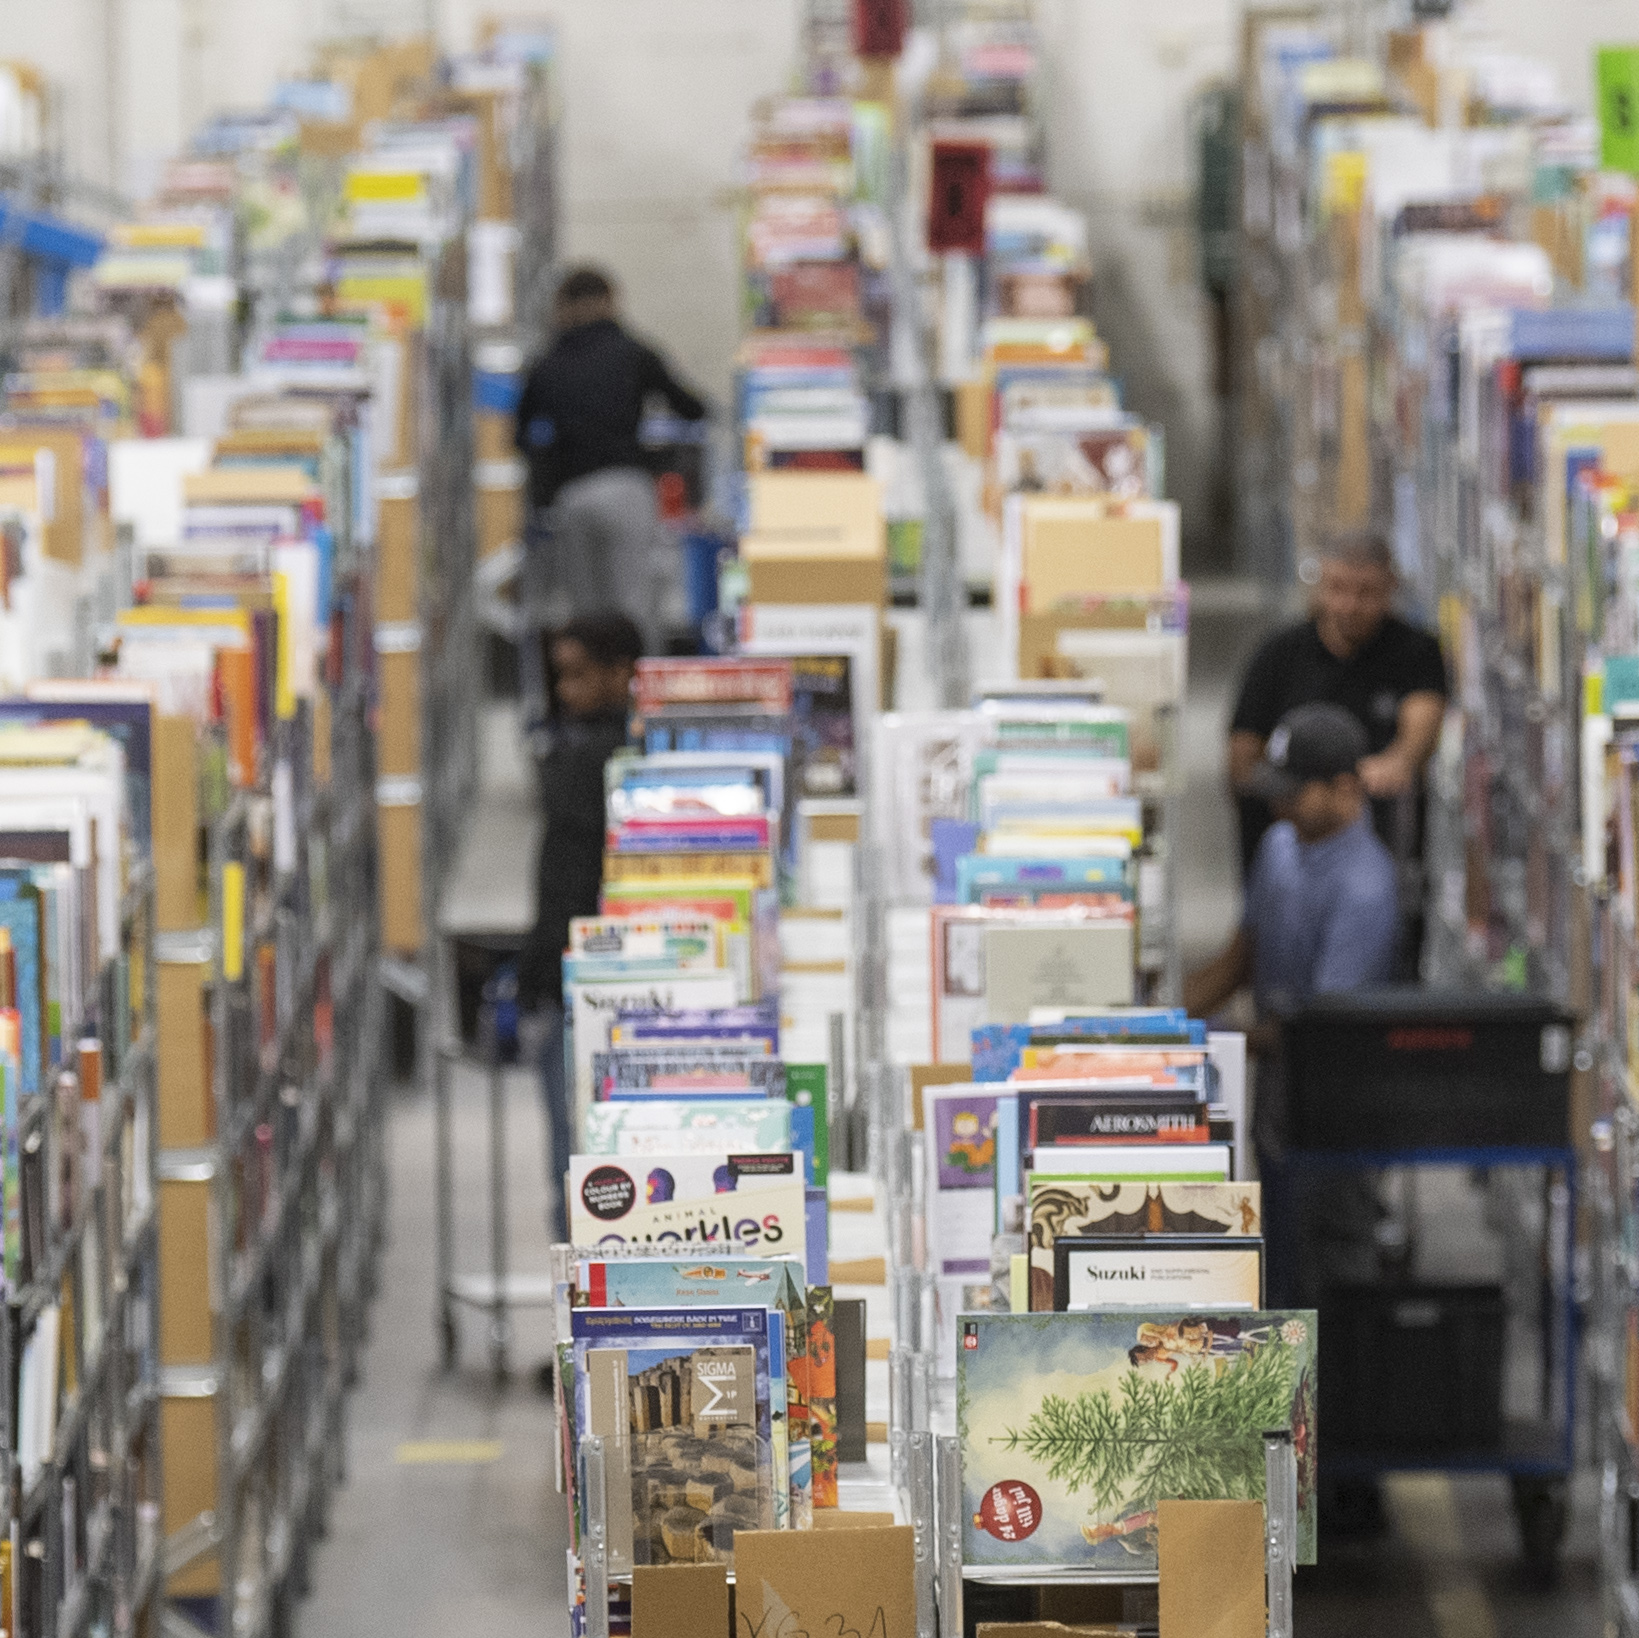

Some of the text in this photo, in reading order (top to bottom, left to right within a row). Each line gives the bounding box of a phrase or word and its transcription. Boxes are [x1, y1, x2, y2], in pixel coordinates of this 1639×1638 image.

[1090, 1113, 1196, 1133] AEROSMITH
[652, 1207, 717, 1224] ANIMAL
[1086, 1265, 1146, 1281] Suzuki
[696, 1362, 737, 1376] SIGMA
[992, 1486, 1017, 1540] 24 dagar
[1008, 1486, 1034, 1529] till jul
